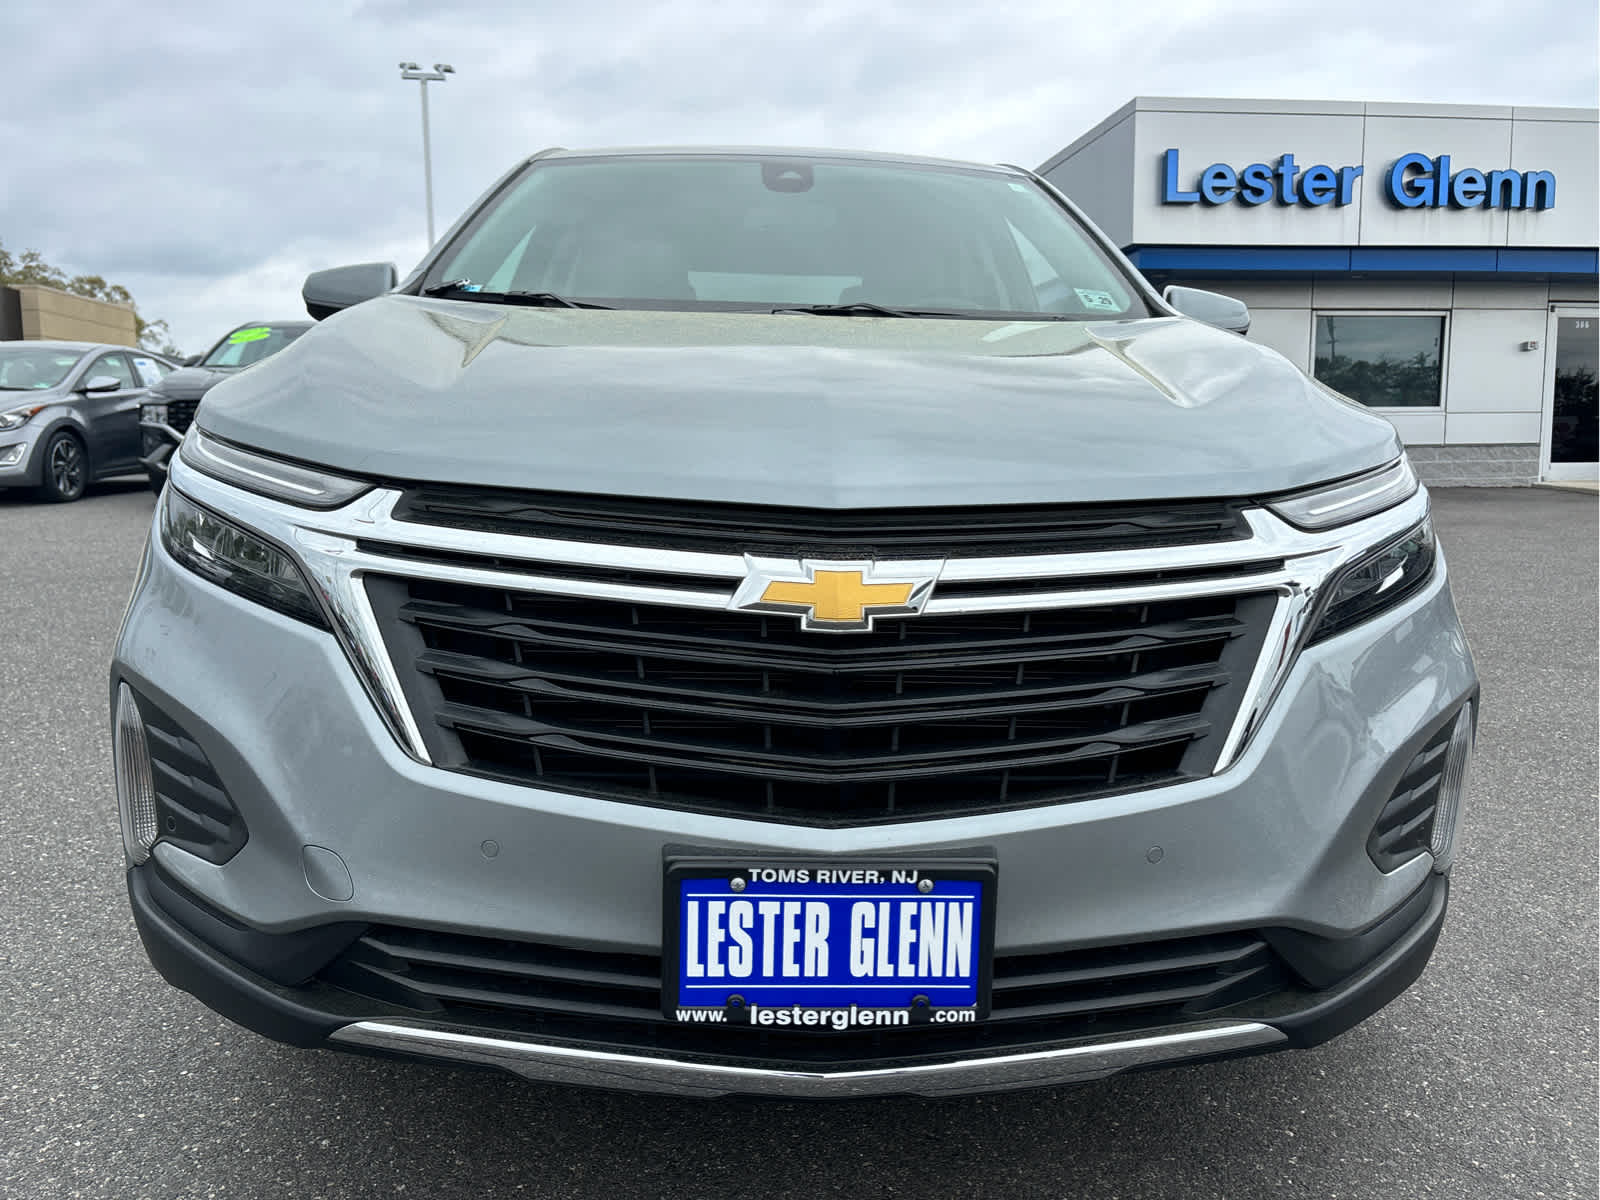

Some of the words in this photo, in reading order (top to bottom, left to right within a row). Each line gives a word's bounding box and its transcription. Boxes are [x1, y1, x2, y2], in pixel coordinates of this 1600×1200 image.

[1162, 148, 1364, 206] Lester
[1386, 152, 1556, 210] Glenn
[748, 869, 810, 883] TOMS
[816, 870, 885, 884] RIVER,
[891, 870, 919, 884] NJ
[686, 900, 830, 978] LESTER
[850, 901, 974, 978] GLENN
[675, 1009, 728, 1023] www.
[750, 1005, 910, 1031] lesterglenn
[929, 1008, 976, 1023] .com
